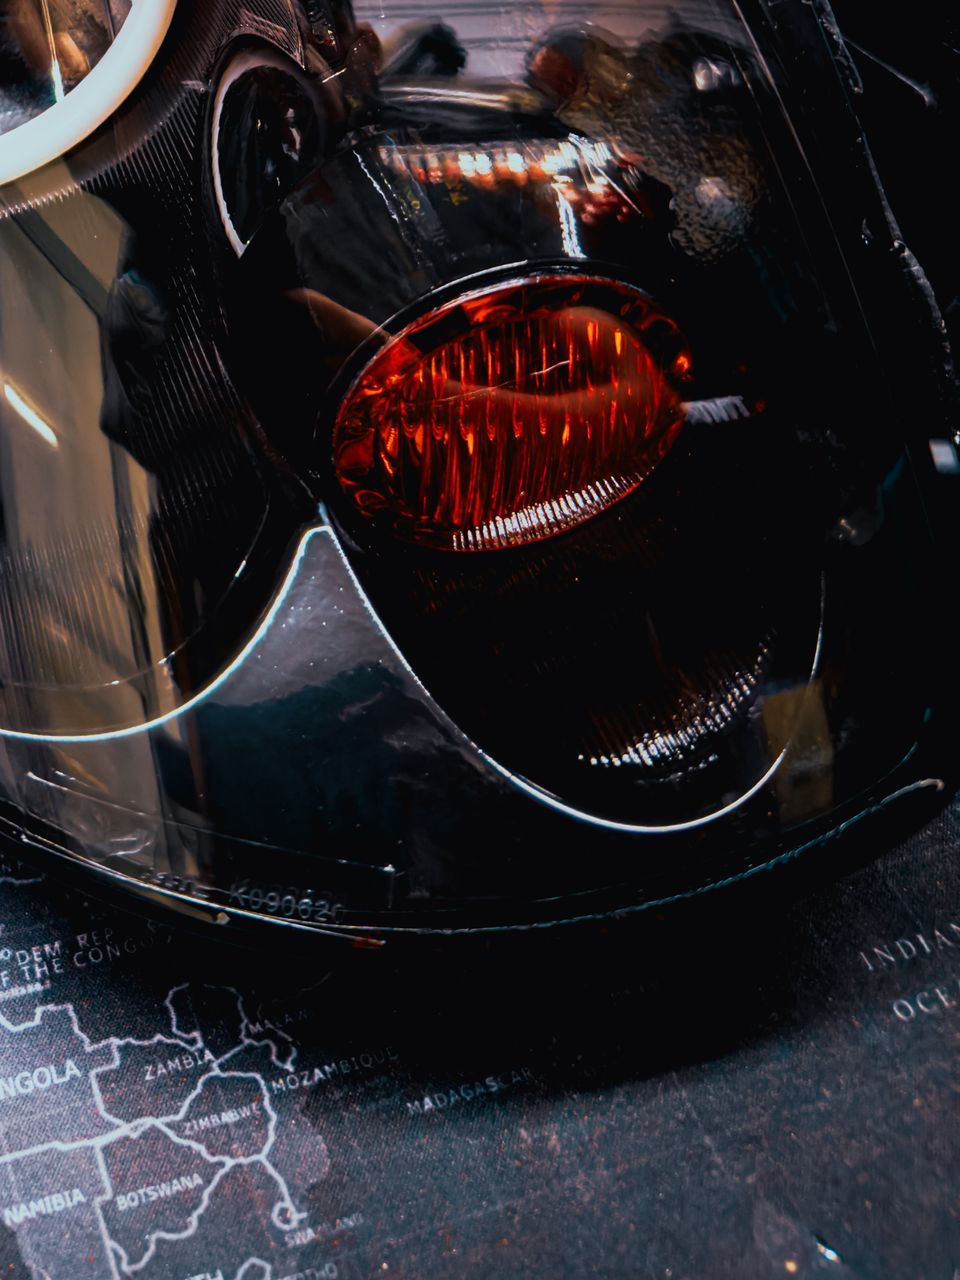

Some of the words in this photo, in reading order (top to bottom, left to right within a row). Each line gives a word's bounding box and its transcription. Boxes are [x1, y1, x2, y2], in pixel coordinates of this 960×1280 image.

[20, 956, 65, 981] THE
[144, 1048, 216, 1081] ZAMBIA
[405, 1067, 533, 1116] MADAGASCAR
[184, 1102, 262, 1135] ZIMBABWE
[3, 1187, 88, 1226] NAMIBIA
[116, 1173, 204, 1211] BOTSWANA
